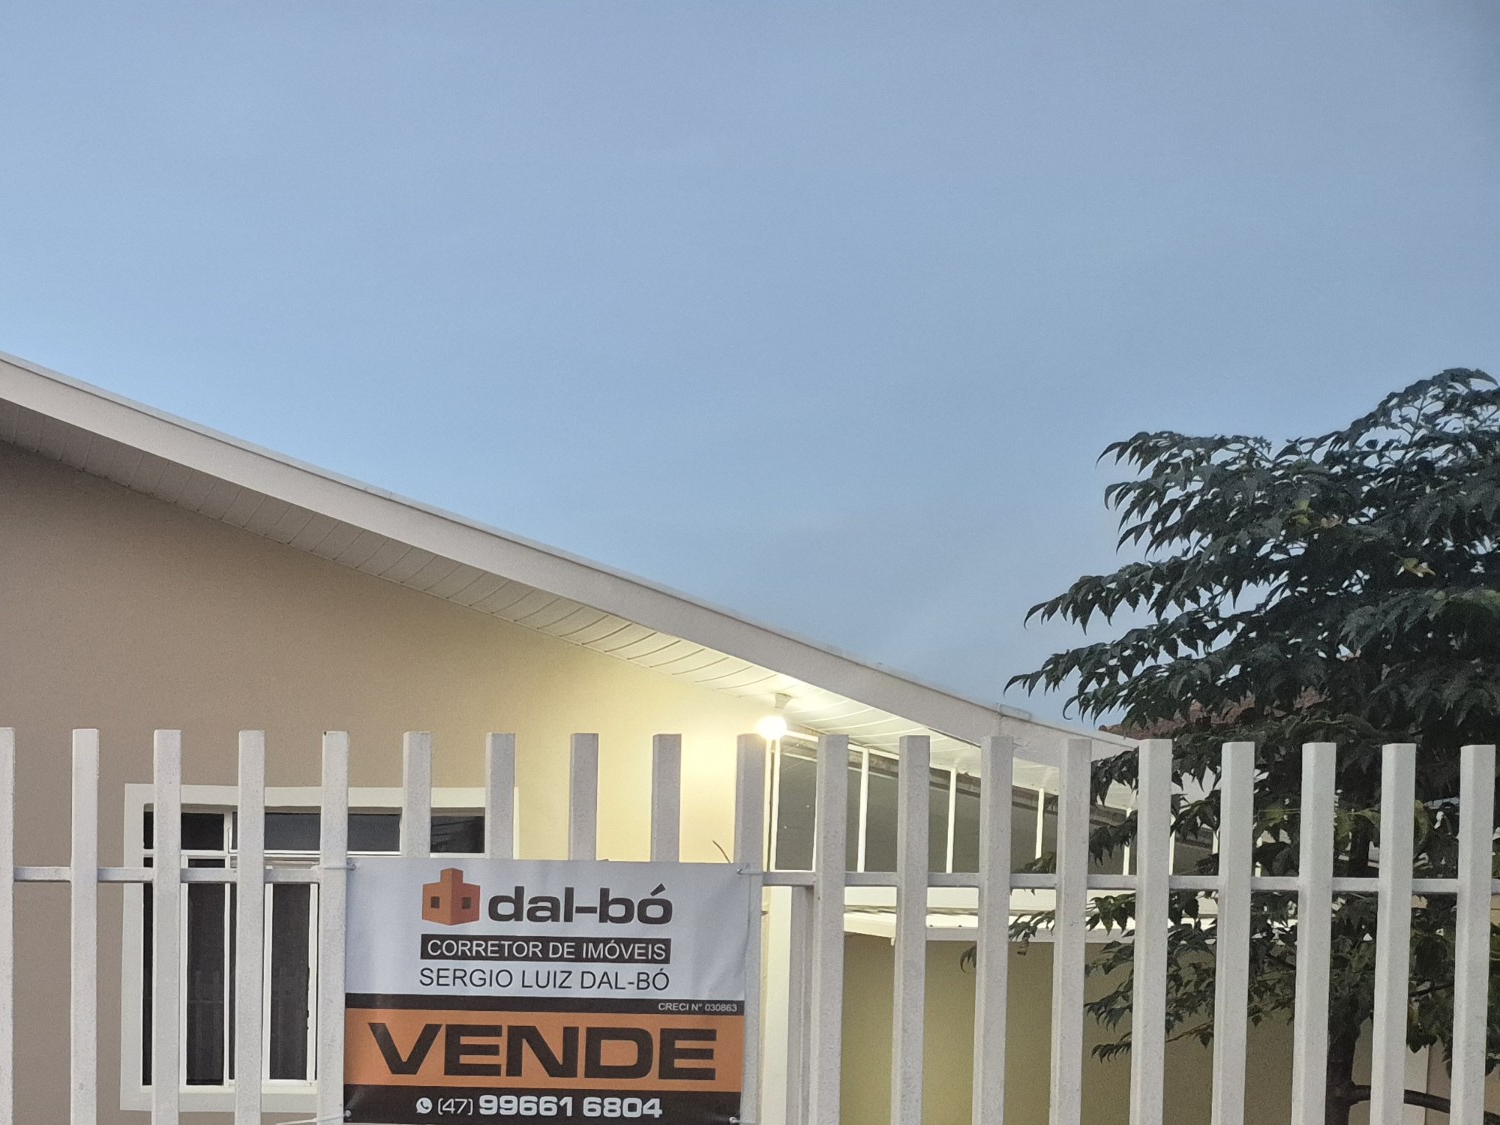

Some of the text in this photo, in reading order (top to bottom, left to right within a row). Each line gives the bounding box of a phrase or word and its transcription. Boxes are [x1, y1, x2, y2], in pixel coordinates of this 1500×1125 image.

[487, 883, 673, 925] dal-bó
[427, 938, 667, 961] CORRETOR DE IMÓVEIS
[418, 967, 671, 991] SERGIO LUIZ DAL-BÓ
[658, 1002, 689, 1012] CRECI
[368, 1022, 718, 1081] VENDE
[437, 1094, 663, 1118] (47) 99661 6804
